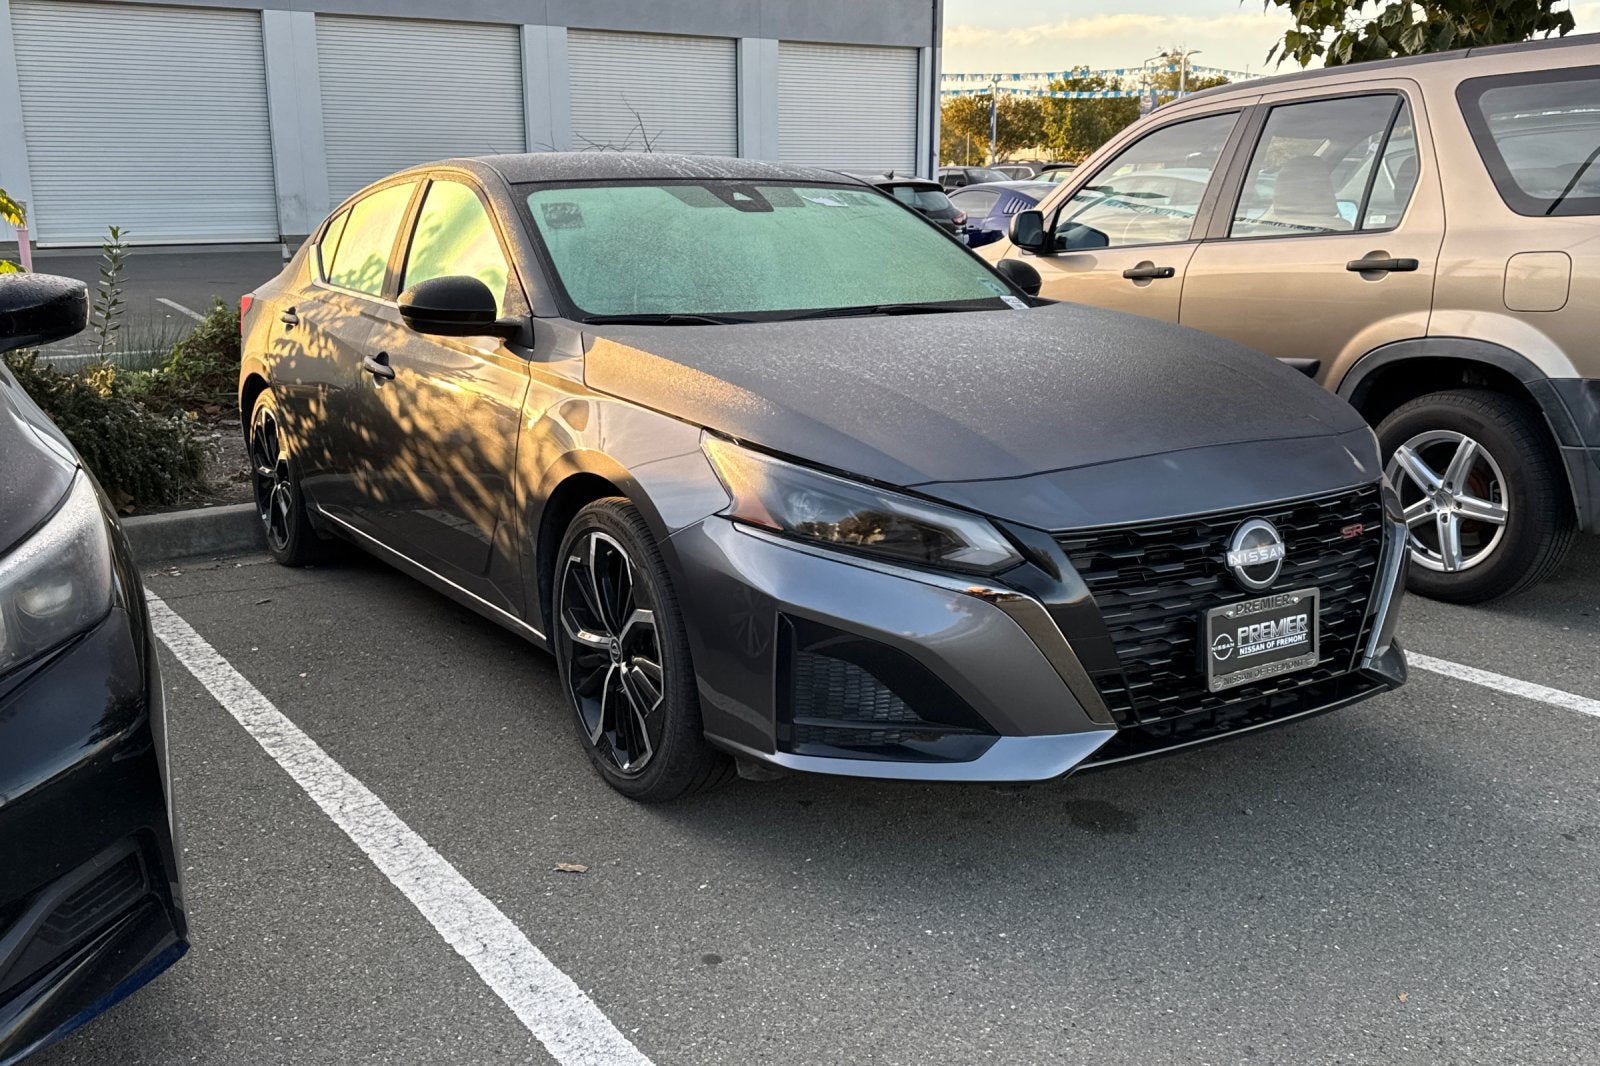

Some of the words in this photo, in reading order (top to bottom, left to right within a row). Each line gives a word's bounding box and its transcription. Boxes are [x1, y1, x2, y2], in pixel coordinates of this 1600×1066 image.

[1340, 523, 1364, 539] SR
[1229, 543, 1285, 565] NISSAN
[1236, 594, 1291, 615] PREMIER
[1237, 614, 1307, 645] PREMIER
[1239, 641, 1265, 655] NISSAN
[1266, 640, 1275, 649] OF
[1276, 633, 1307, 647] FREMONT
[1223, 671, 1252, 686] NISSAN
